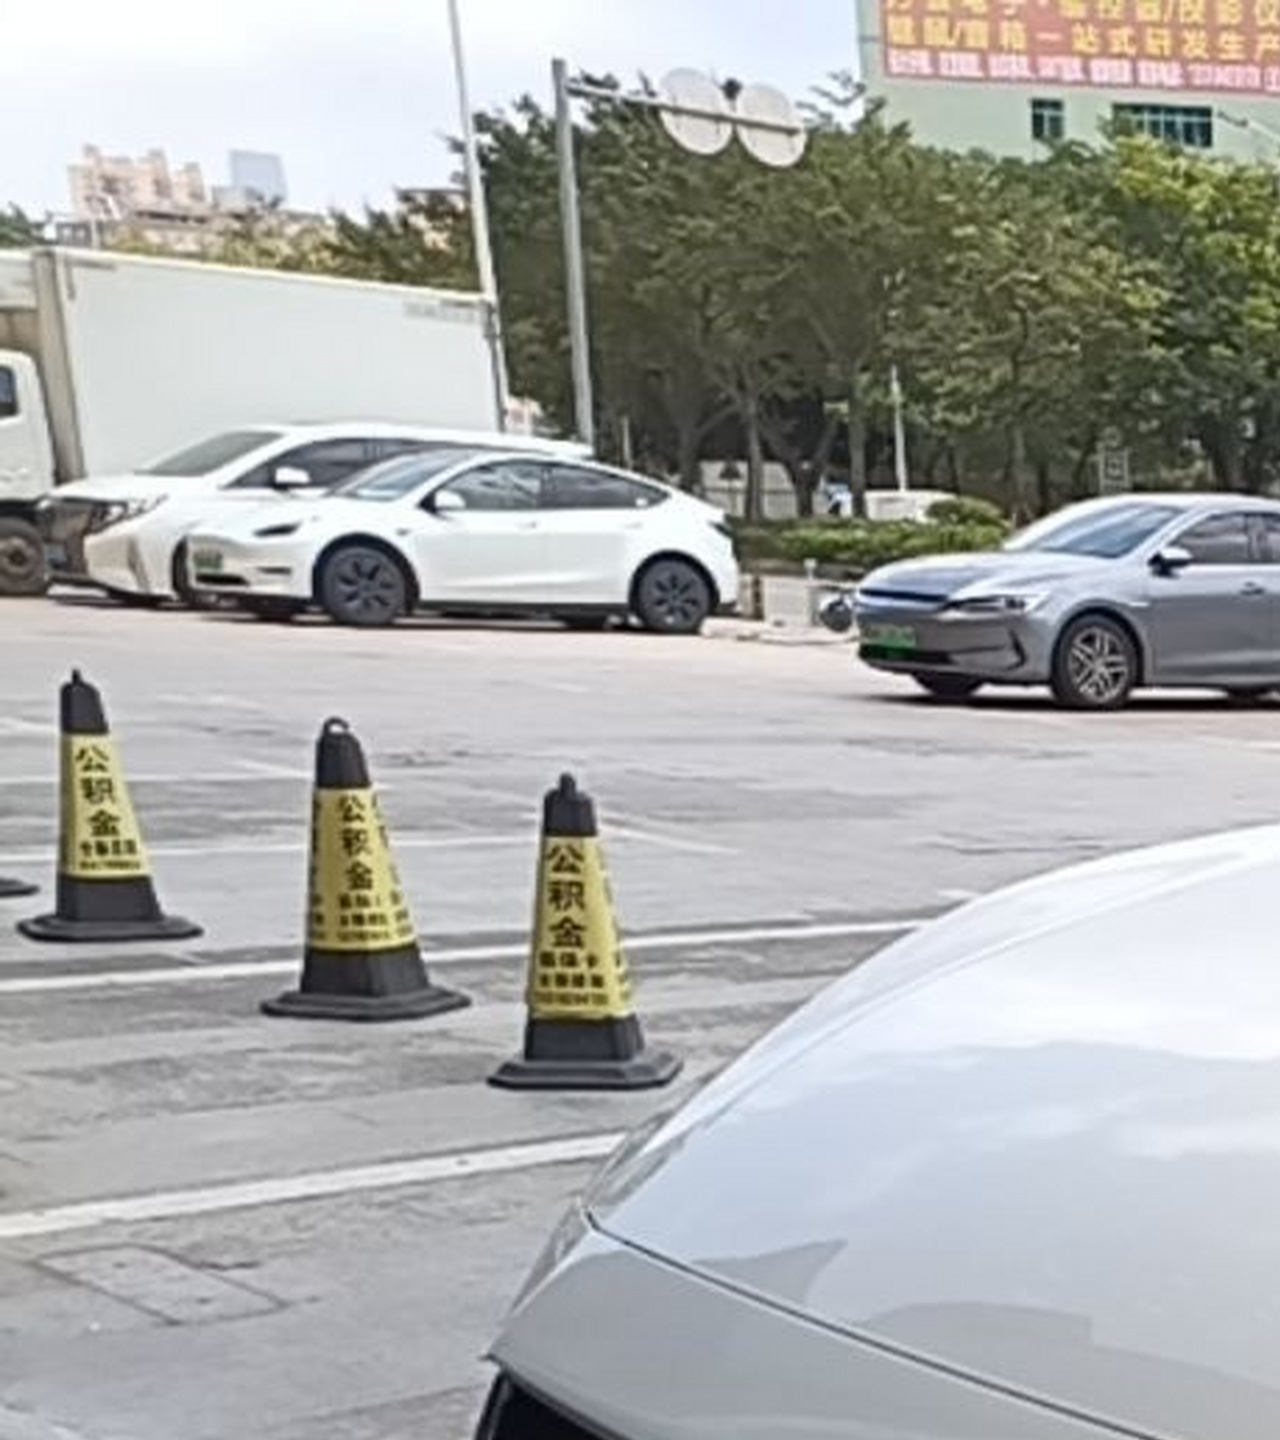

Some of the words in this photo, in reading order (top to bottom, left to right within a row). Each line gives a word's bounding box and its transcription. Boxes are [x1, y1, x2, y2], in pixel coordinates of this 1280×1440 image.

[75, 745, 120, 836] 公积金
[338, 795, 373, 890] 公积金
[546, 844, 586, 948] 公积金
